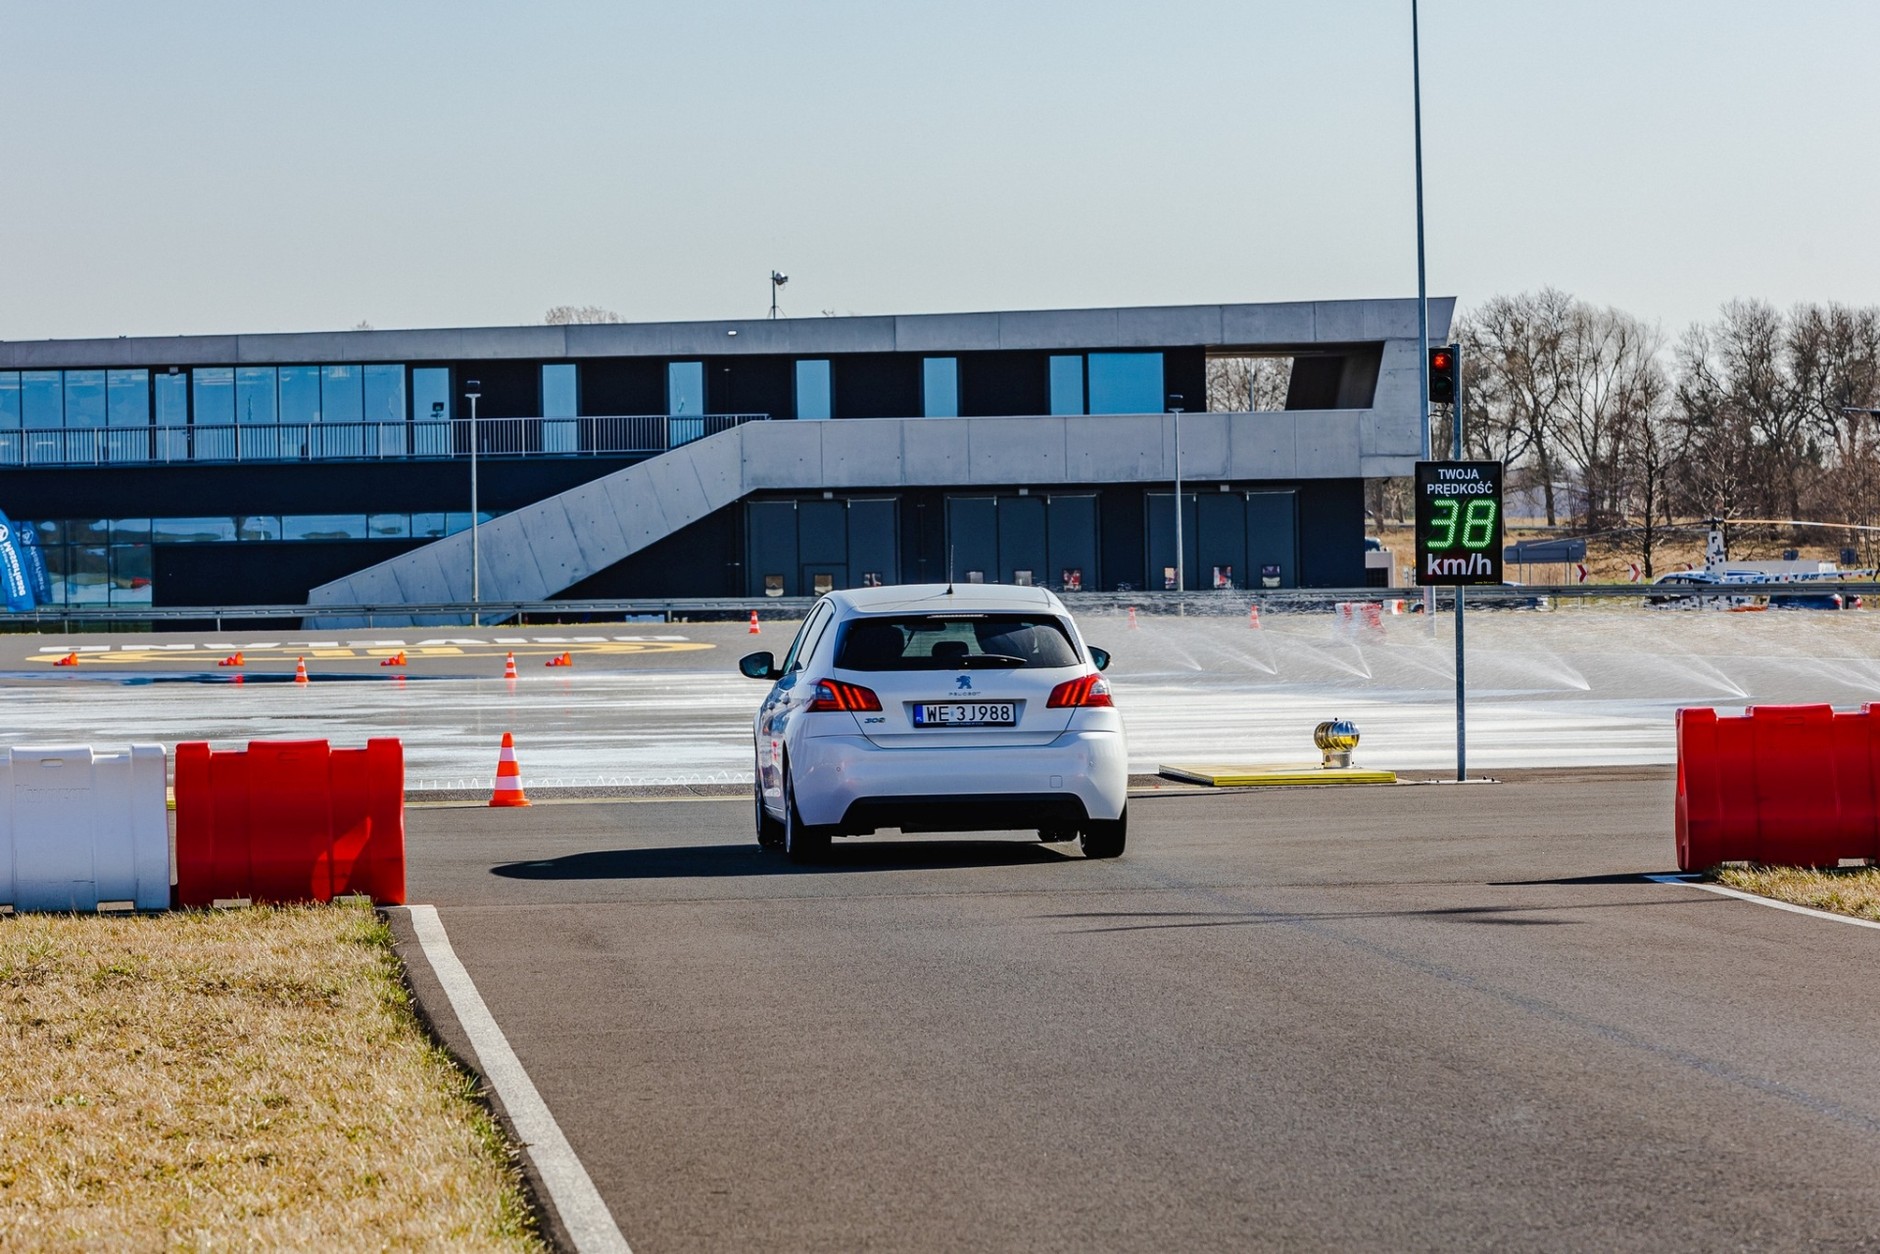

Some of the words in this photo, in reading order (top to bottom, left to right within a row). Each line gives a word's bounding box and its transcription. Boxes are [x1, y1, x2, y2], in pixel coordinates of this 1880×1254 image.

[1438, 469, 1480, 480] TWOJA
[1427, 481, 1493, 497] PRĘDKOŚĆ
[1427, 499, 1497, 548] 38
[1427, 553, 1492, 575] km/h
[926, 706, 950, 722] WE
[956, 705, 1010, 721] 3J988
